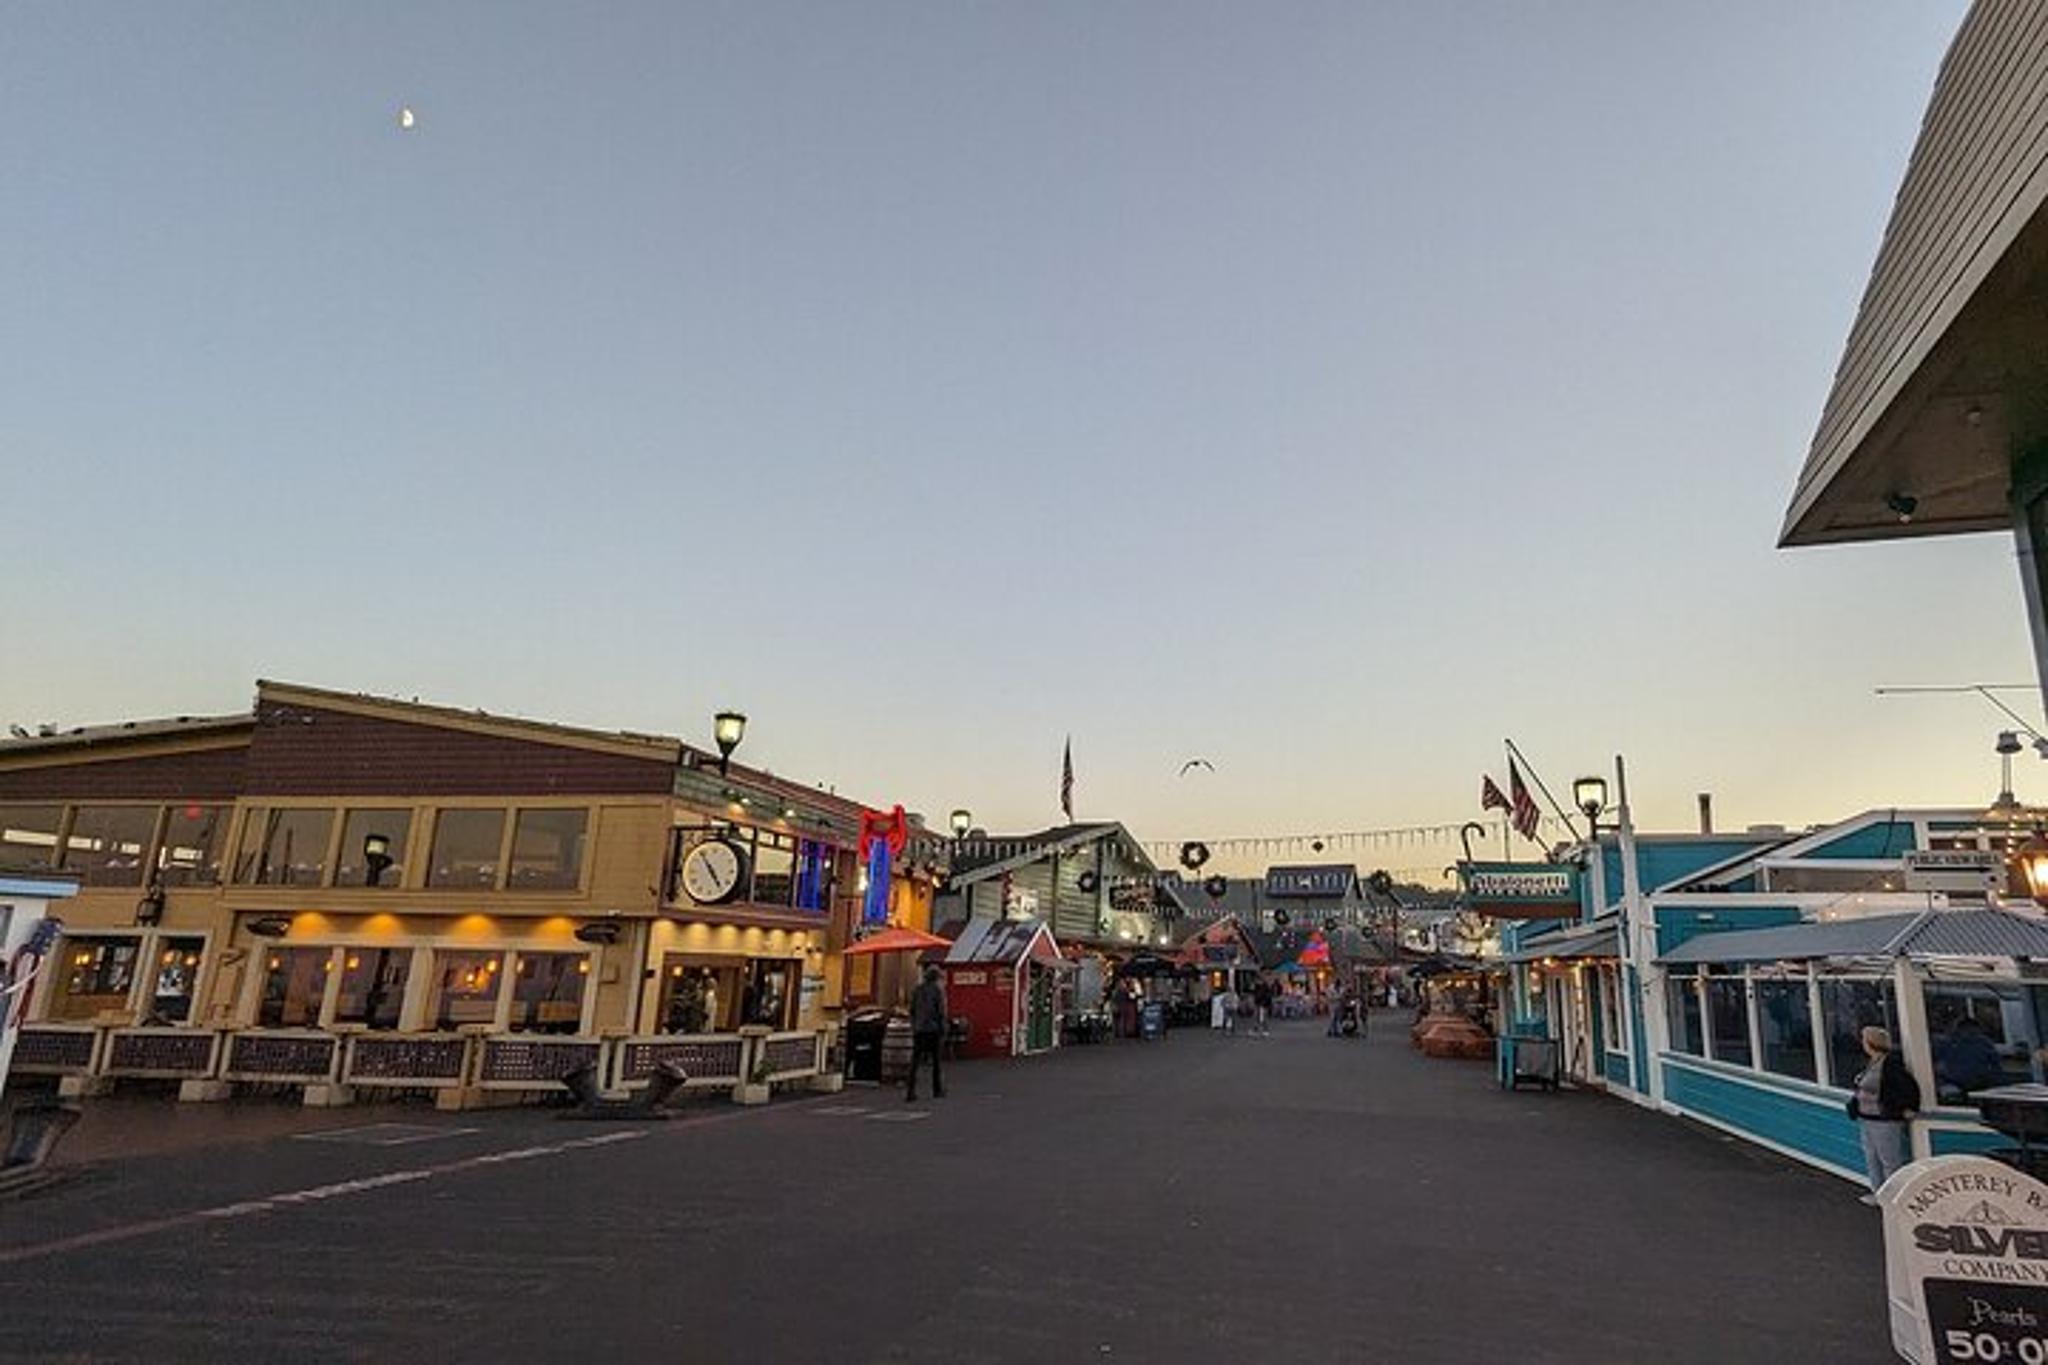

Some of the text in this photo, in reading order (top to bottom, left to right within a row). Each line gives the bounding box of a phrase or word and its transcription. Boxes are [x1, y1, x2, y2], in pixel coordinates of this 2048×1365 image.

[1907, 1173, 2048, 1218] MONTEREY B
[1944, 1260, 2048, 1281] COMPANY
[1968, 1297, 2037, 1326] Pearls
[2018, 1336, 2048, 1365] O
